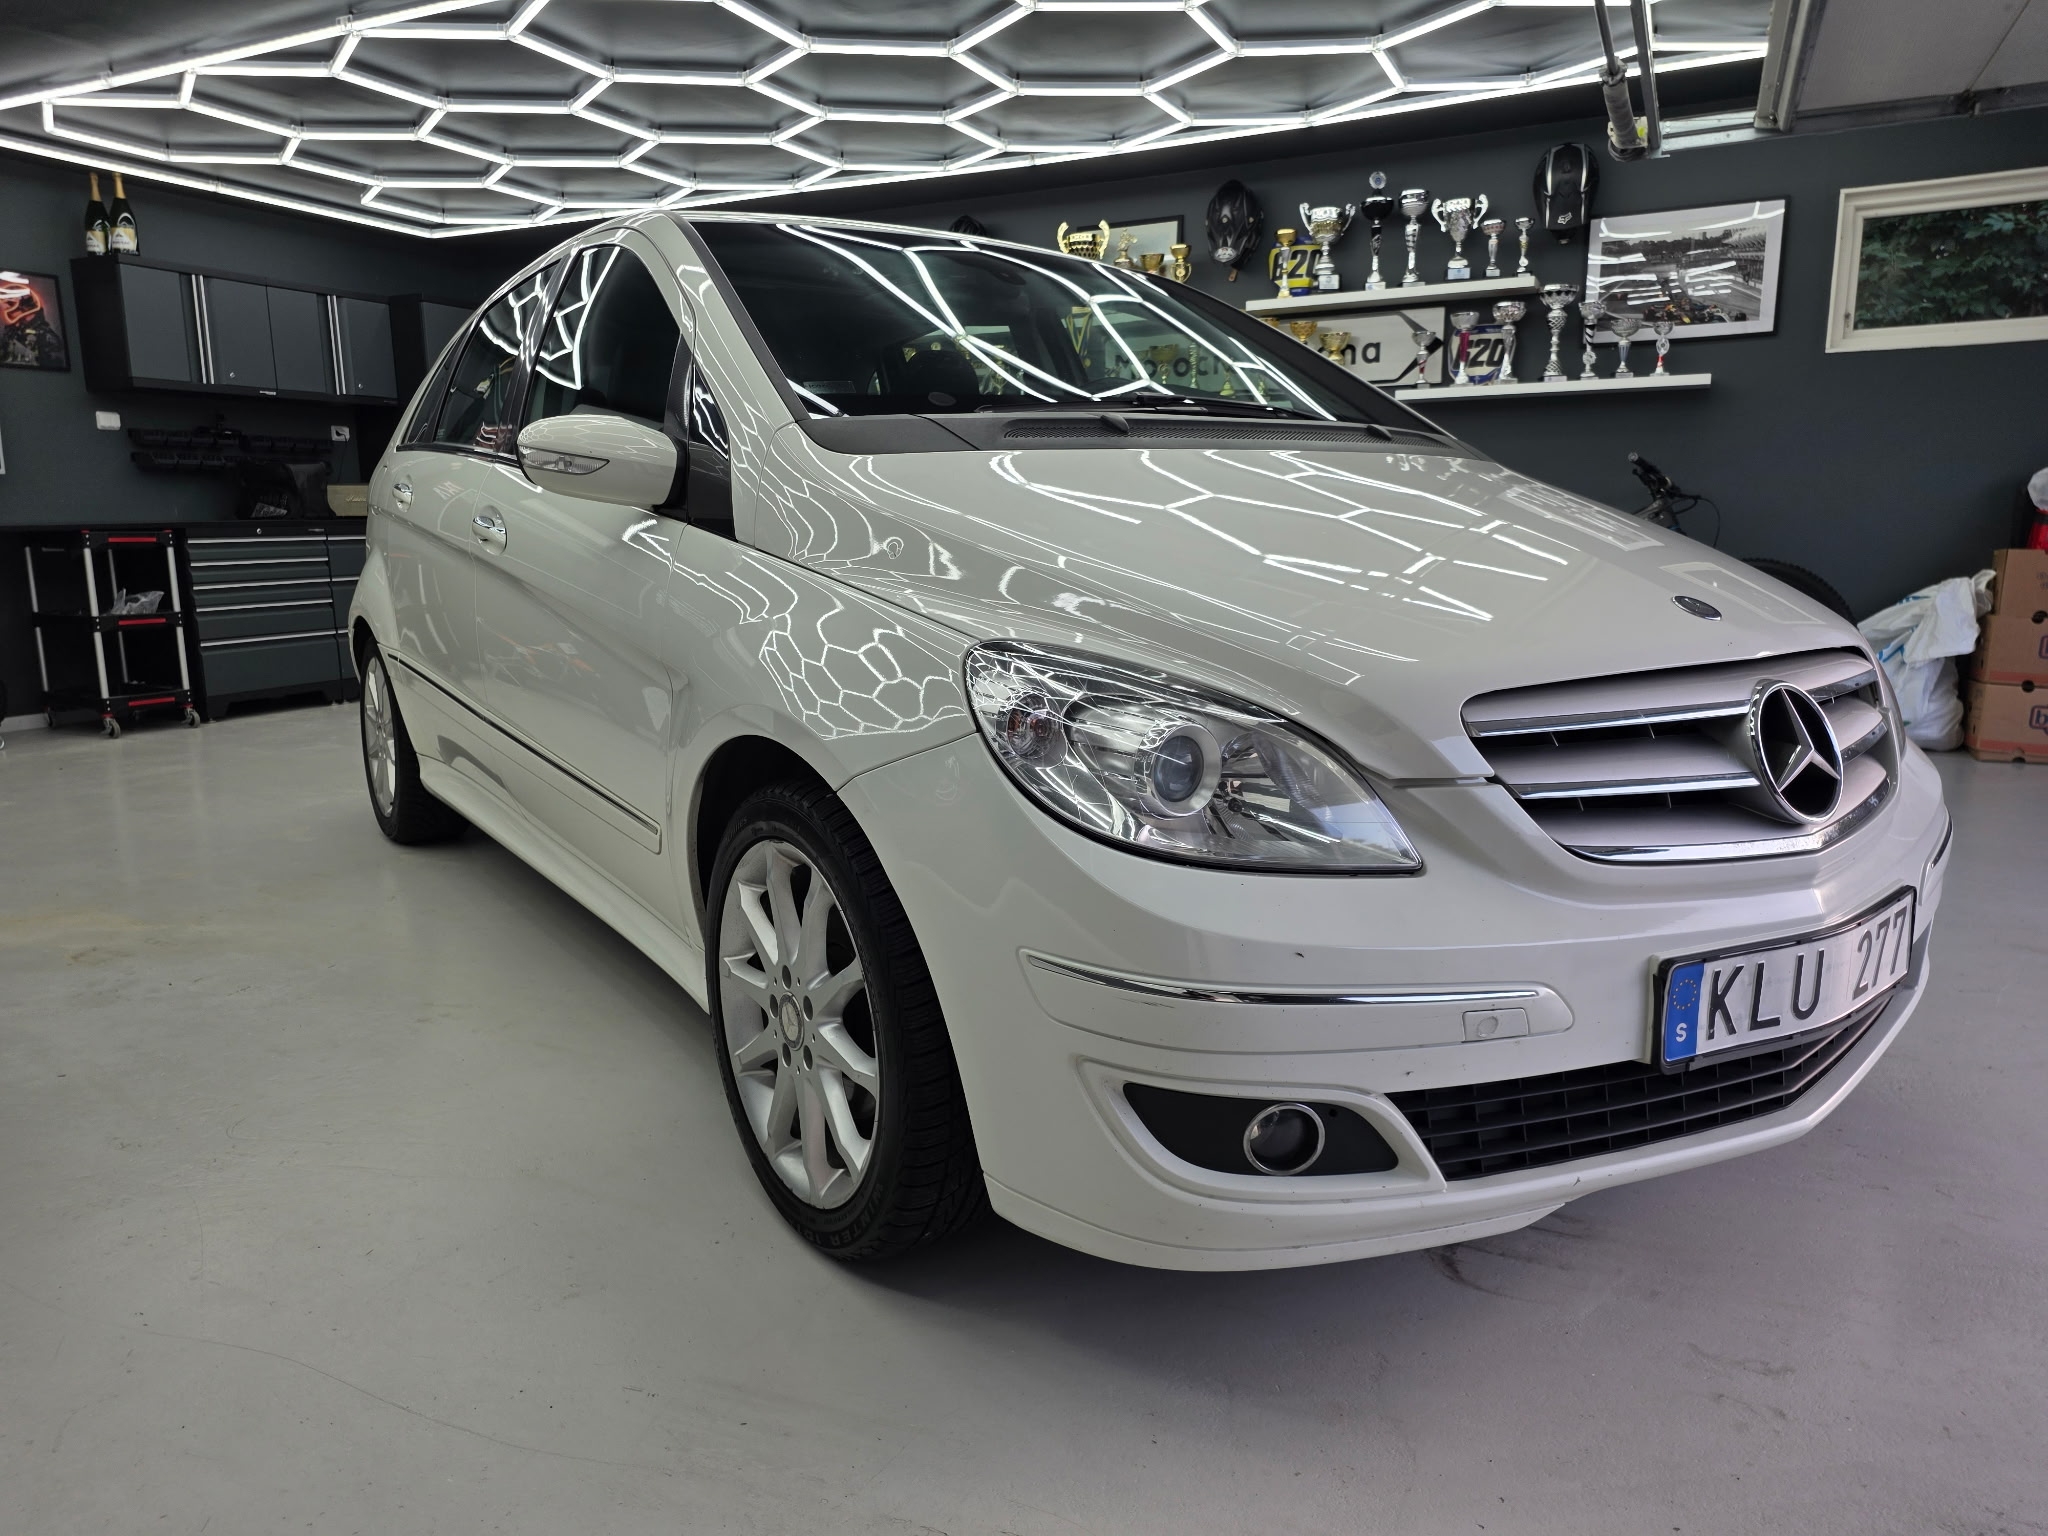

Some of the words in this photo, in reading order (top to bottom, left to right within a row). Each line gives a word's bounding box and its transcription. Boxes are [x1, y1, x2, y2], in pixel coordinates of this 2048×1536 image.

[1706, 948, 1825, 1041] KLU
[1852, 905, 1907, 1001] 277
[1675, 1023, 1688, 1043] S
